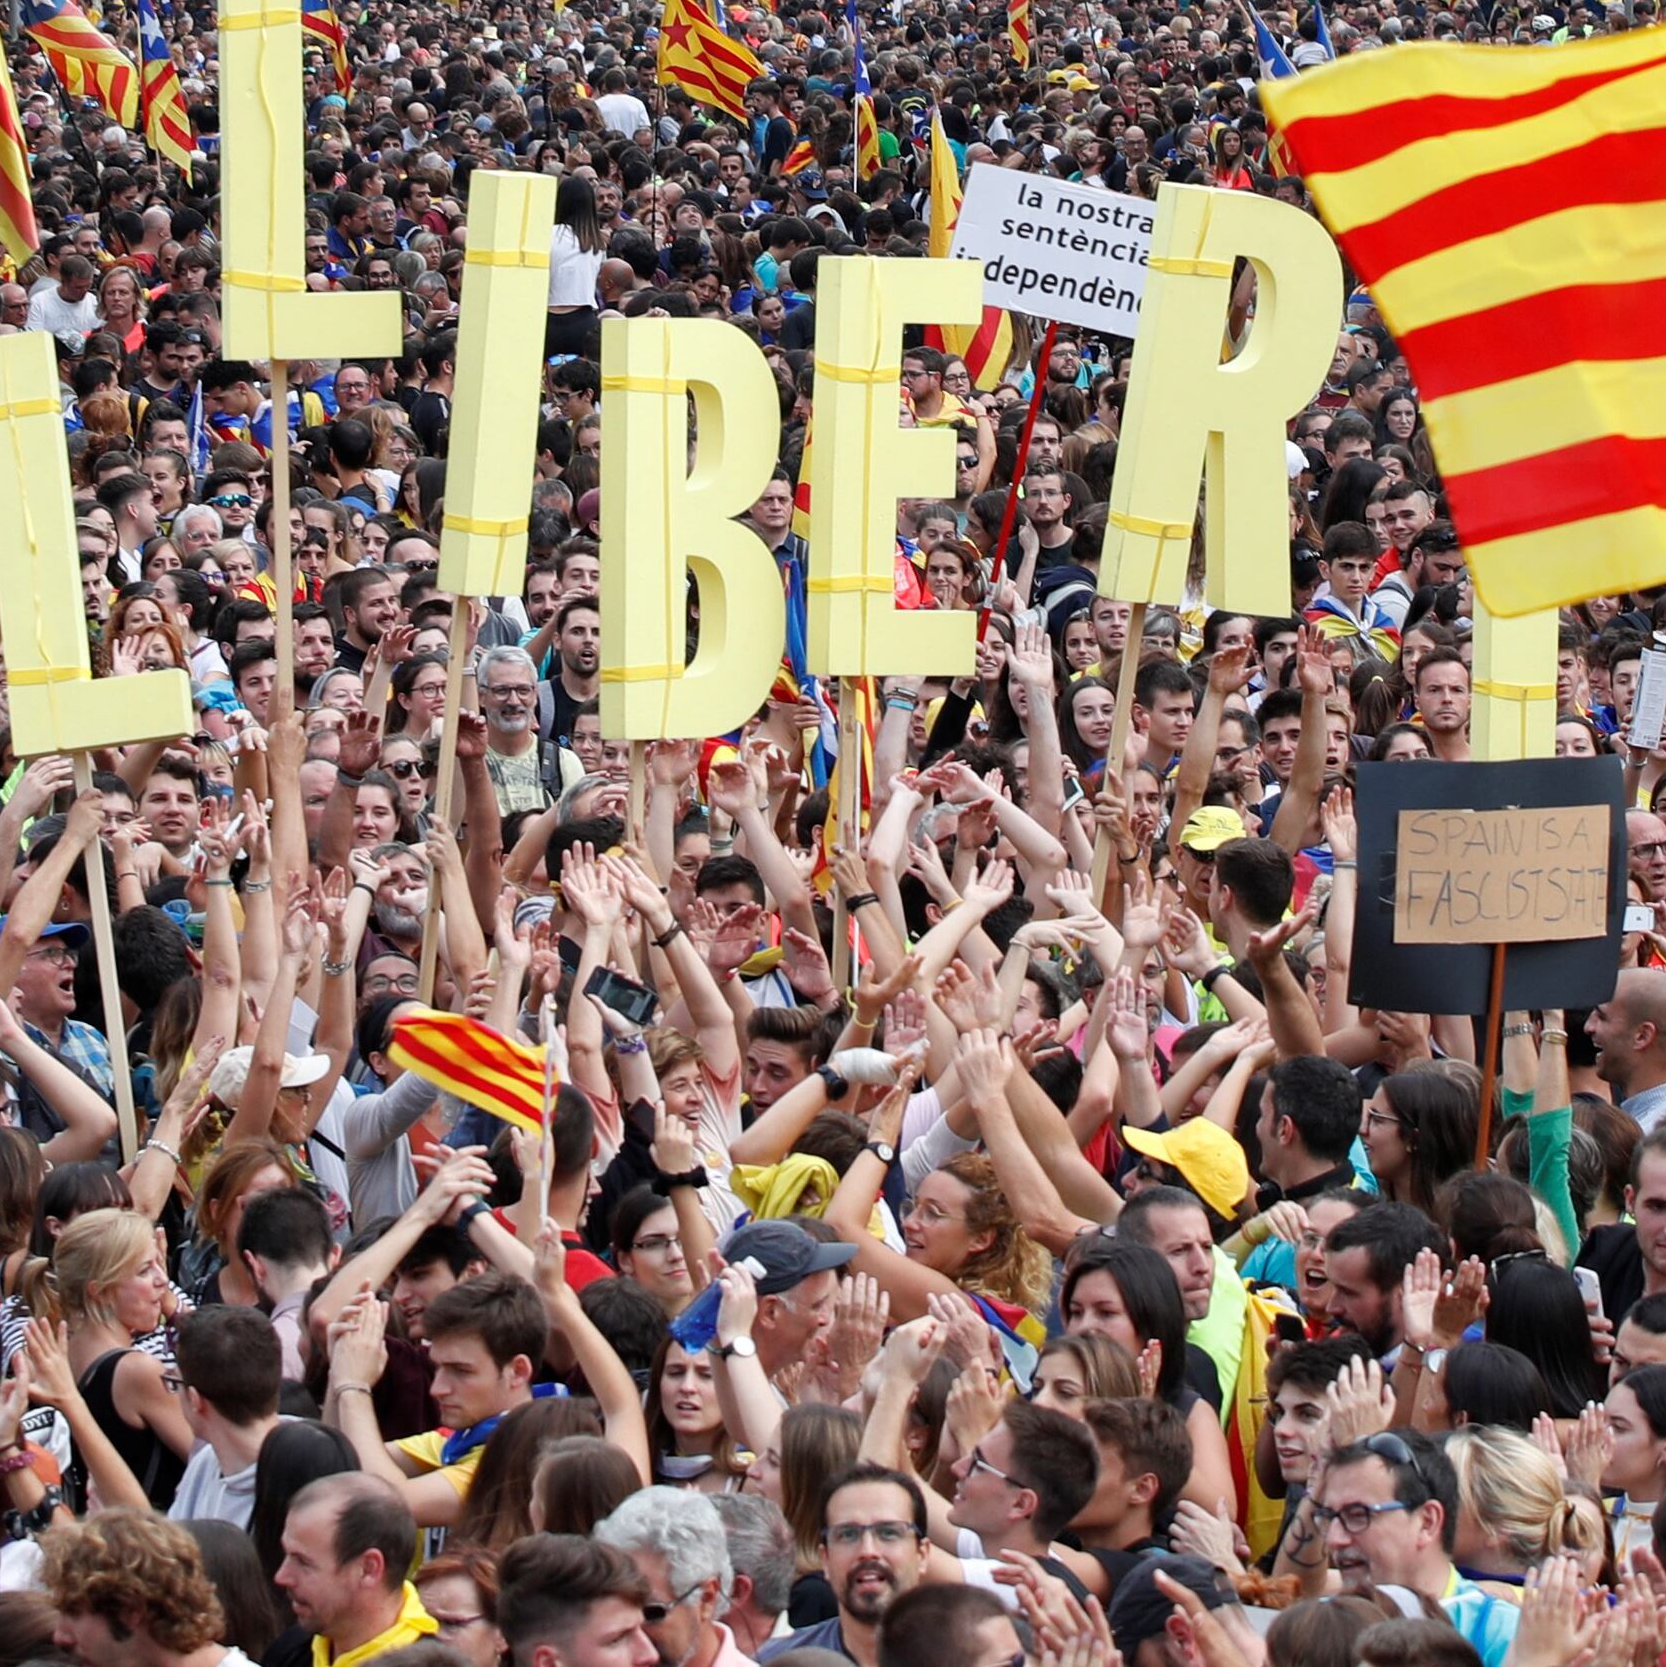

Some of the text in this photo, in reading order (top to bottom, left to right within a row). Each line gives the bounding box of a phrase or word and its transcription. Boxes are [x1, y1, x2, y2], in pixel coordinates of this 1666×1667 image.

[1017, 182, 1153, 234] la nostra
[1001, 216, 1151, 266] sentència
[956, 246, 1143, 314] dependèn
[1409, 811, 1592, 857] SPAIN IS A
[1406, 866, 1607, 931] FASCIST STATE
